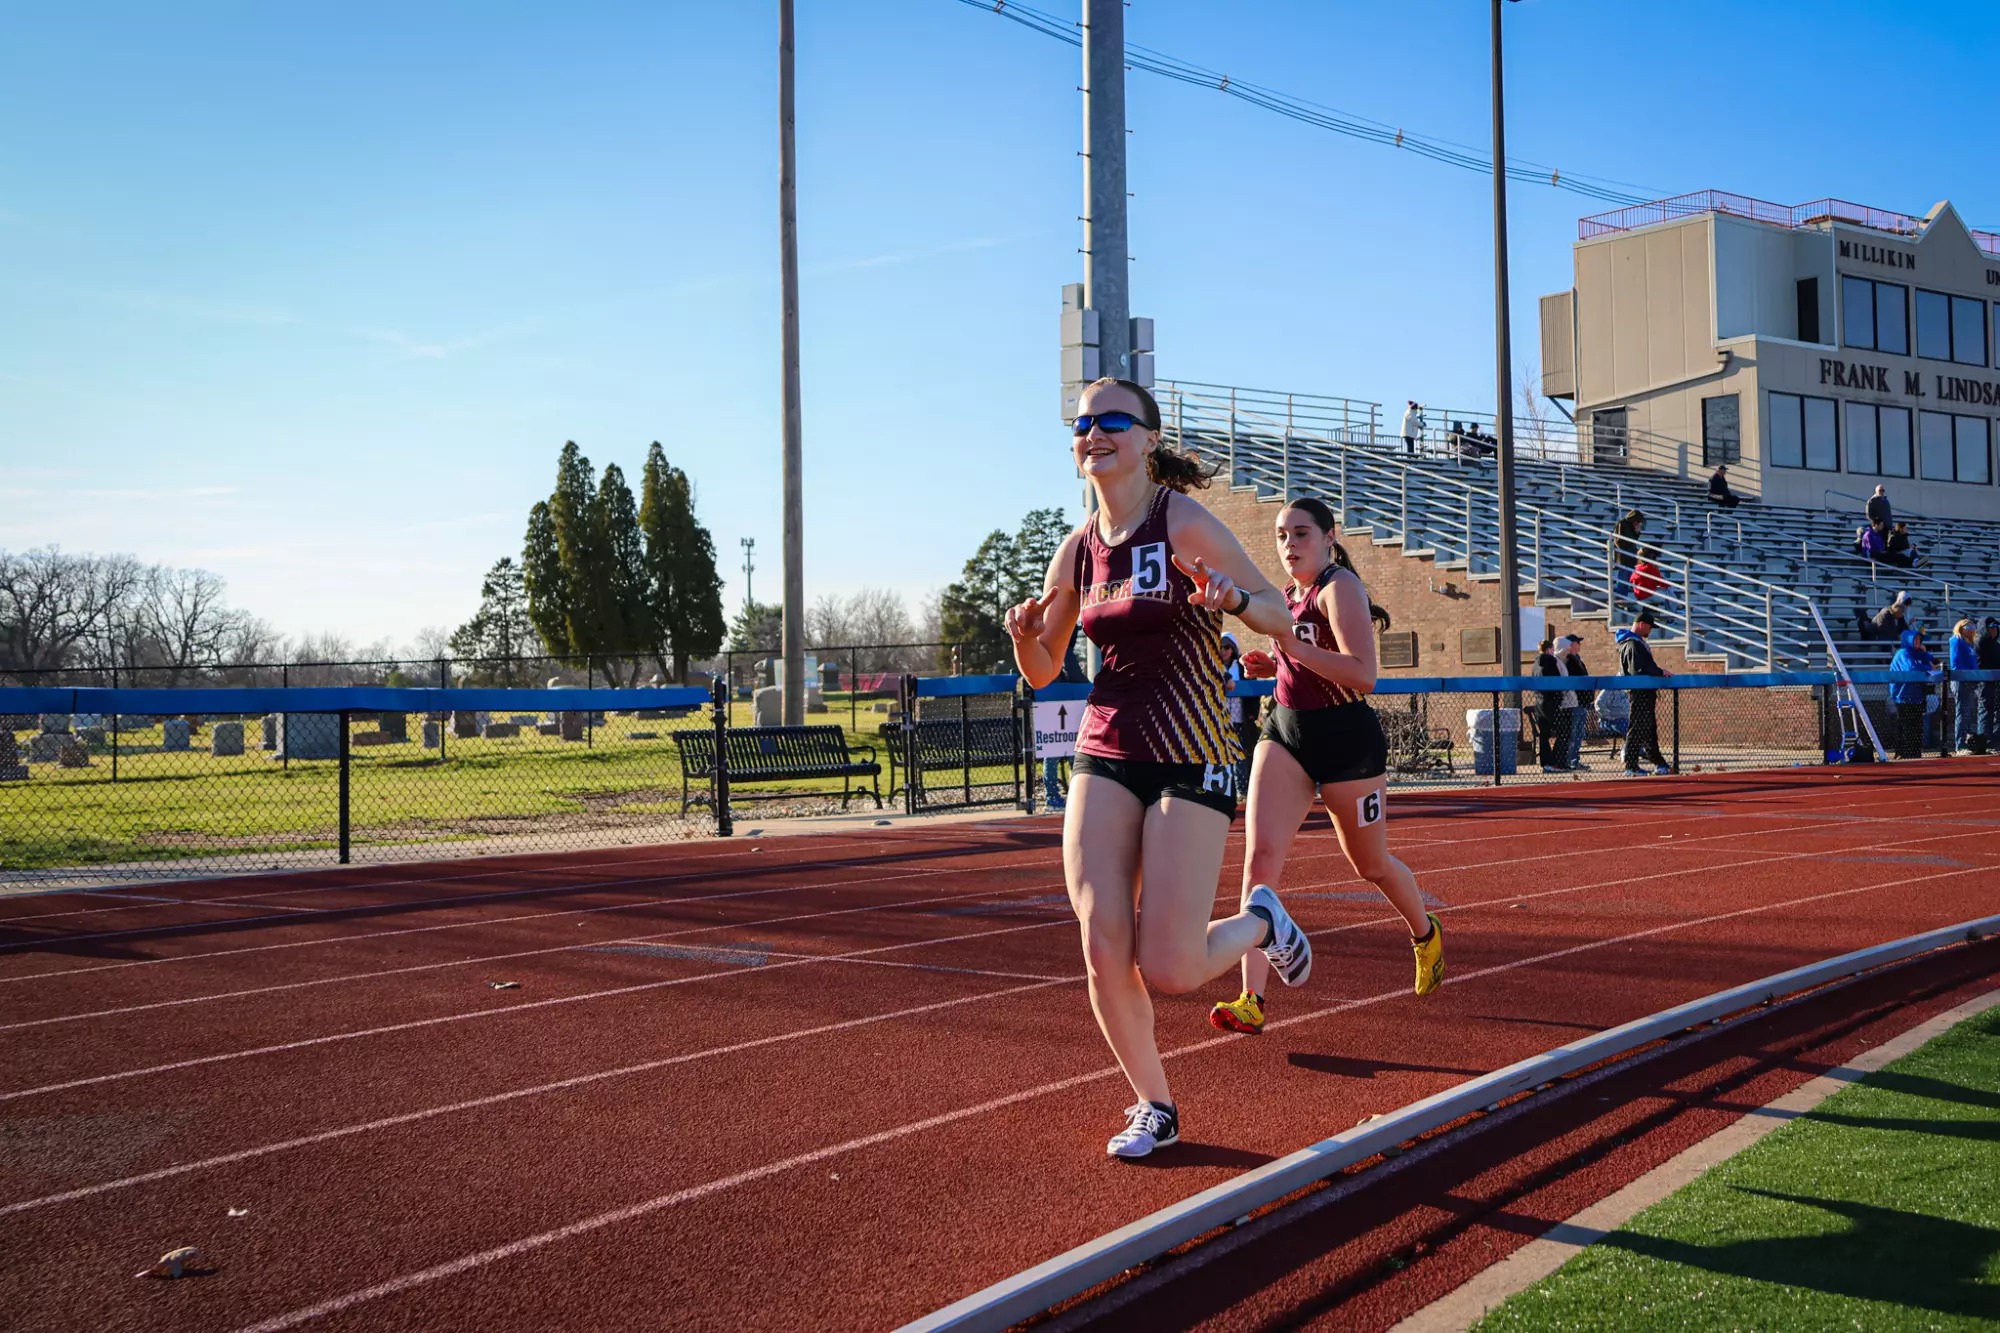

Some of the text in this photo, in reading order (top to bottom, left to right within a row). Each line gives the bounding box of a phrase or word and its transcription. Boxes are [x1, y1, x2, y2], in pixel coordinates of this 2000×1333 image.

[1839, 239, 1916, 270] MILLIKIN
[1819, 358, 1891, 393] FRANK
[1904, 370, 1926, 397] M.
[1138, 544, 1161, 590] 5
[1035, 730, 1078, 744] Restroo
[1363, 792, 1379, 823] 6
